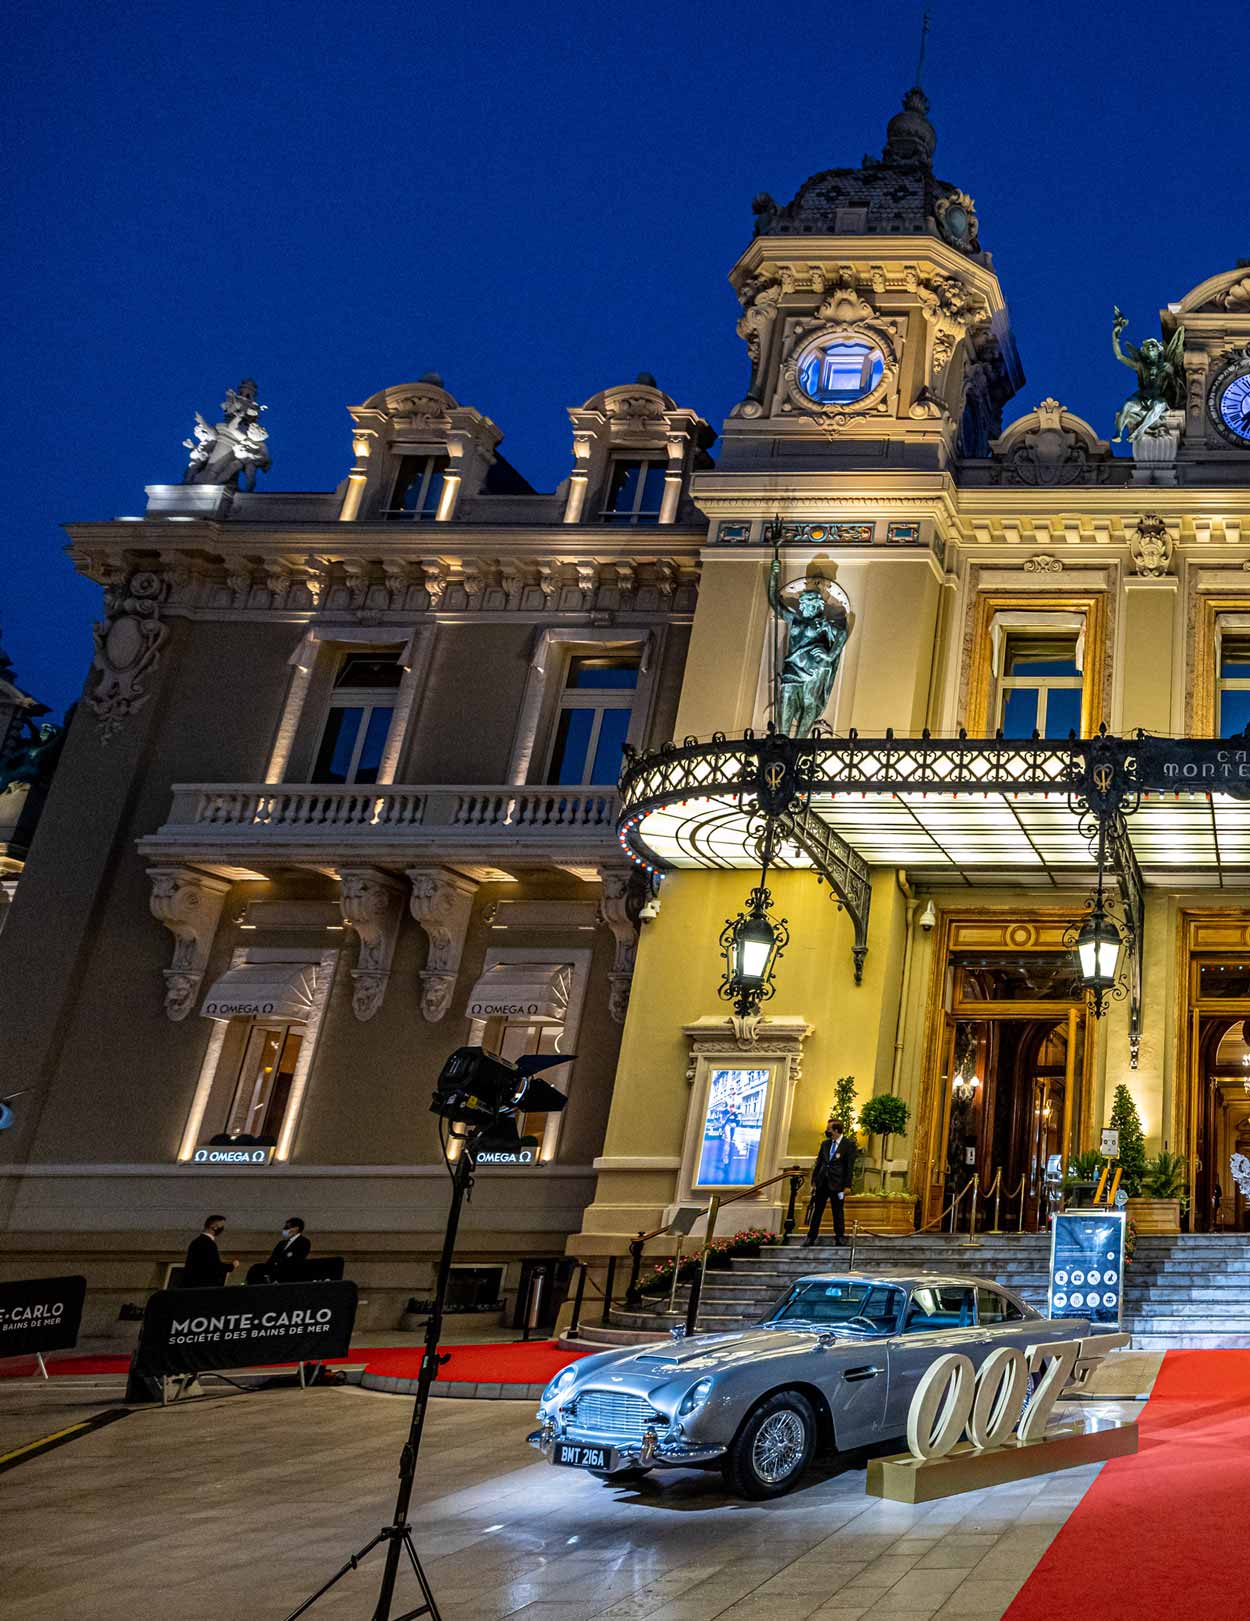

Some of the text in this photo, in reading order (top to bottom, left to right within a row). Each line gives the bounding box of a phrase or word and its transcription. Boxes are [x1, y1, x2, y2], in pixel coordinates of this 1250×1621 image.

[220, 1004, 259, 1014] OMEGA
[484, 1004, 525, 1014] OMEGA
[209, 1151, 250, 1162] OMEGA
[477, 1152, 516, 1162] OMEGA
[3, 1321, 28, 1331] BAINS
[43, 1317, 61, 1326] MER
[168, 1324, 330, 1345] SOCIÉTÉ DES BAINS DE MER
[907, 1340, 1080, 1460] 007
[561, 1446, 604, 1466] BMT 216A
